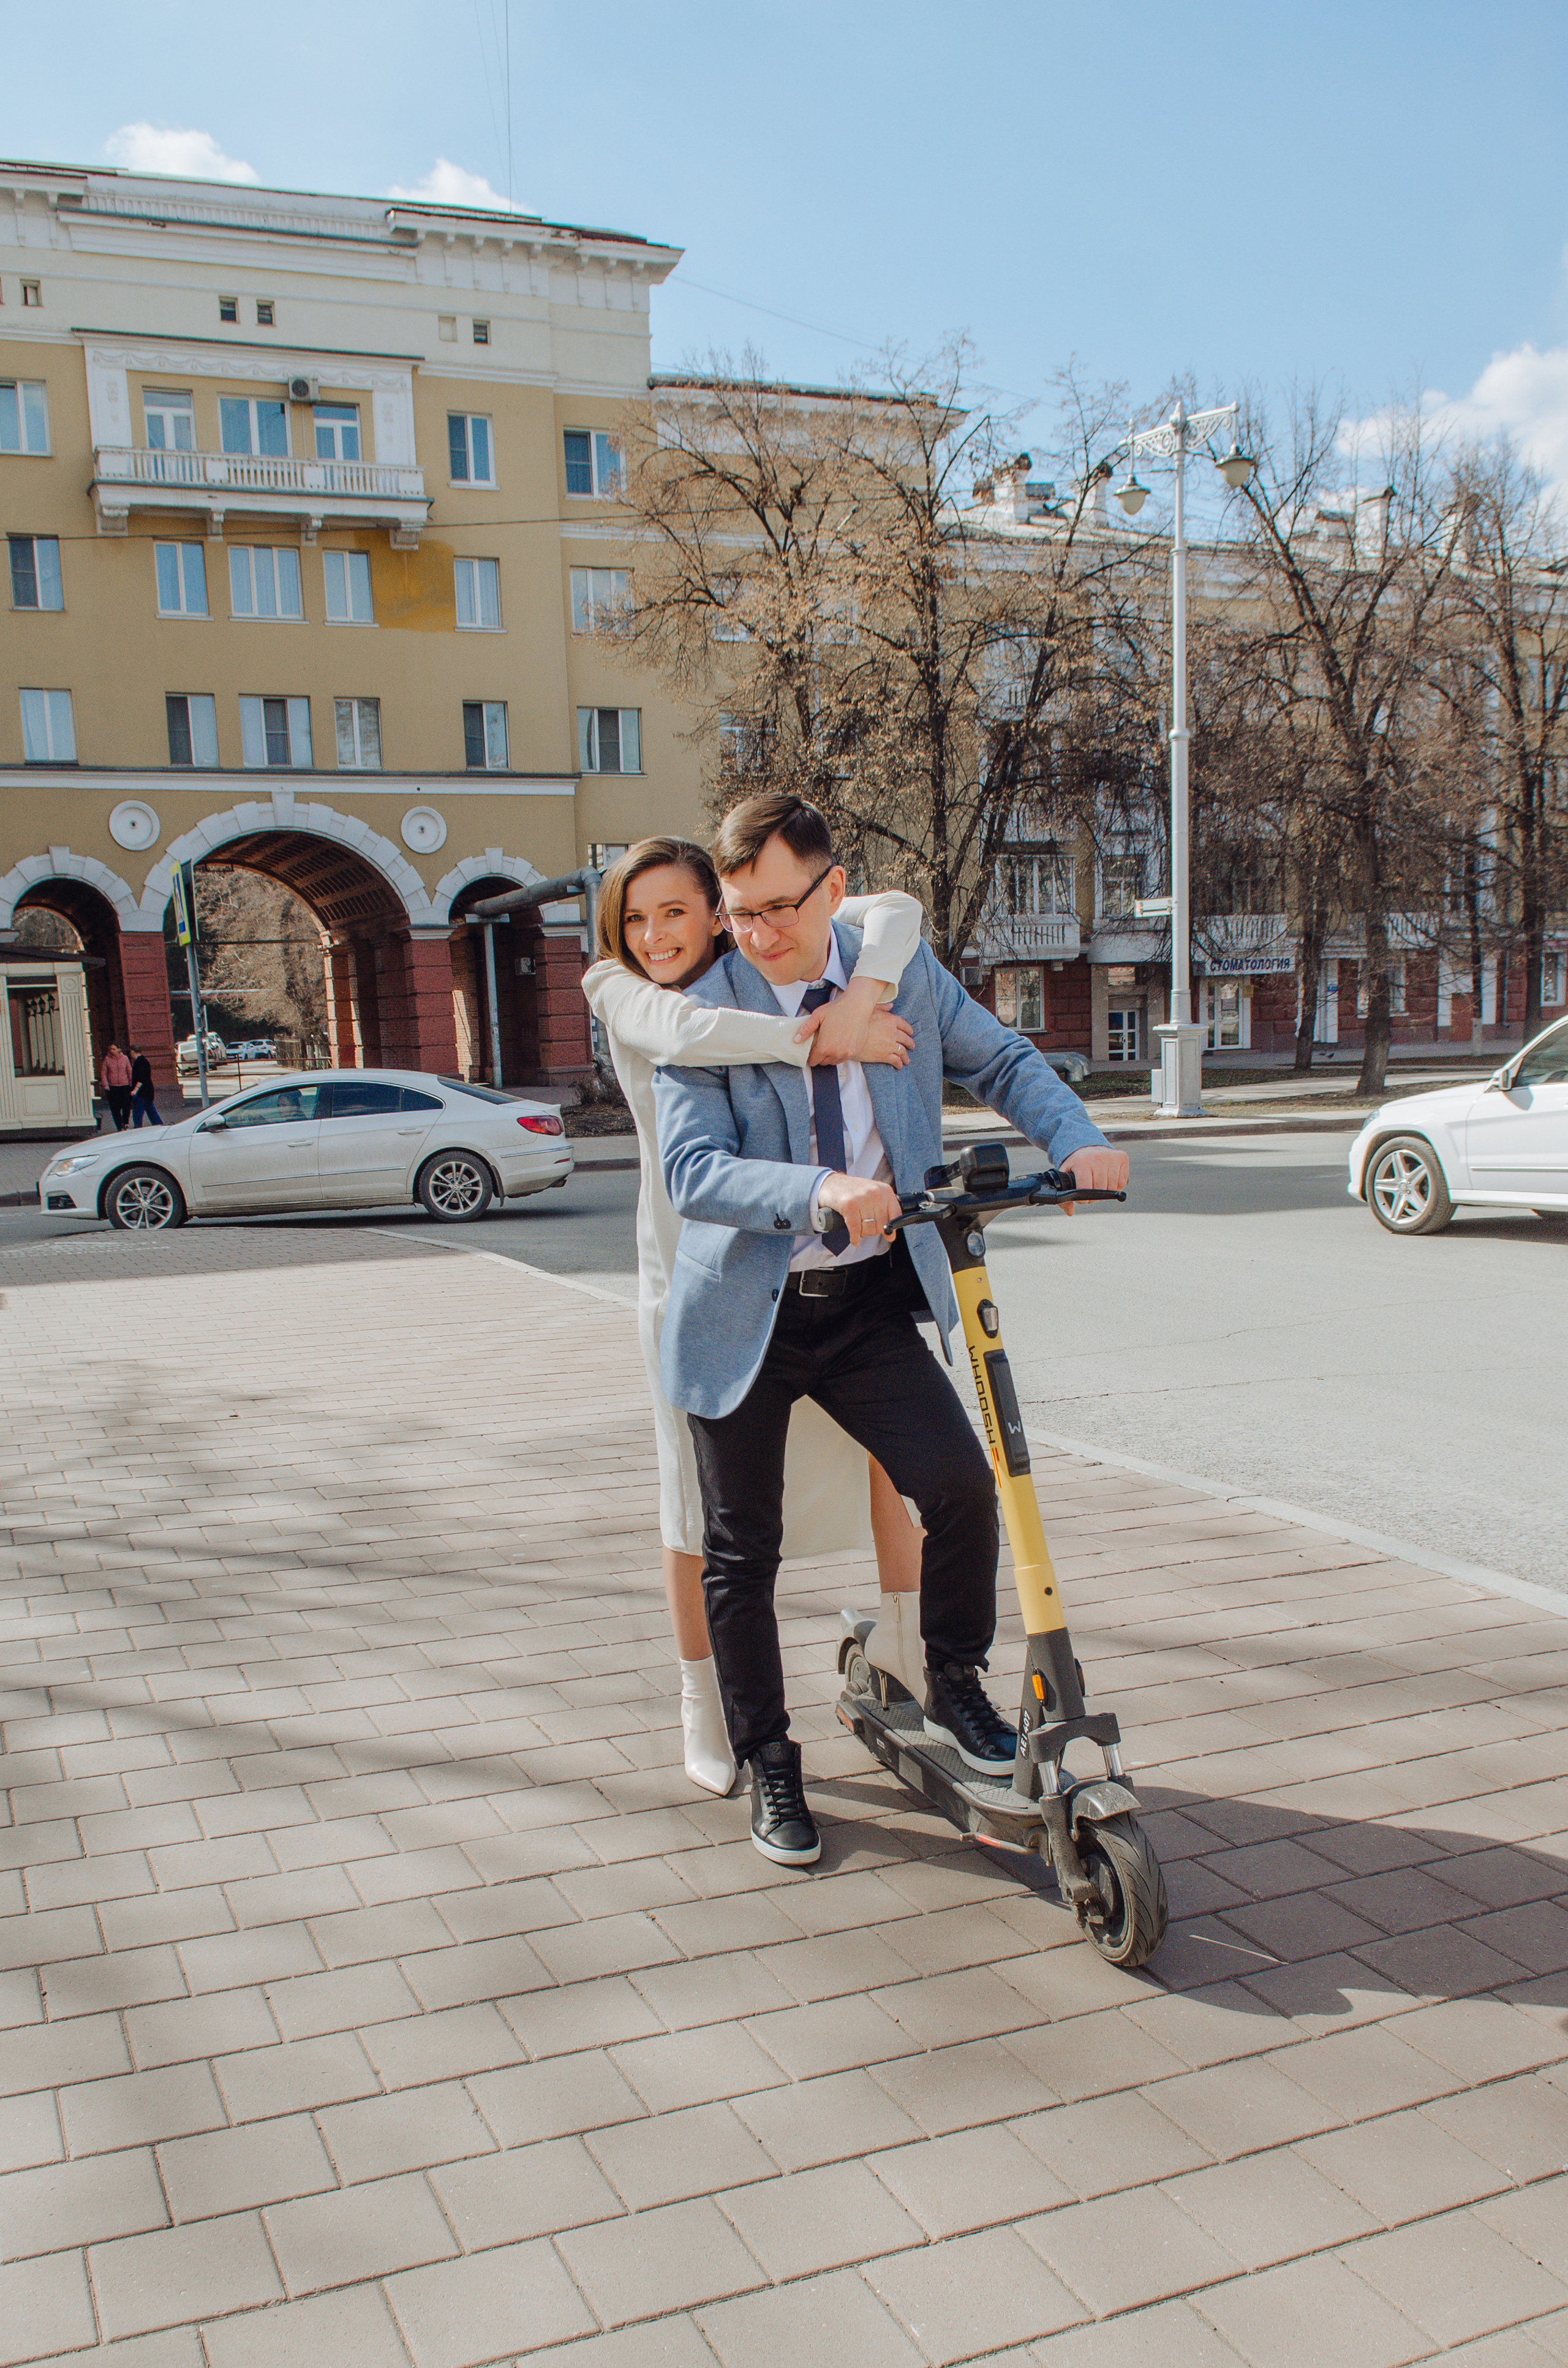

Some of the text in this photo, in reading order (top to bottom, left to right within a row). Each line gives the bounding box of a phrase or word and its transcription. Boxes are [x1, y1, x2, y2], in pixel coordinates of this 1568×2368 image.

[1210, 958, 1290, 972] СТОМАТОЛОГИЯ
[968, 1345, 996, 1444] WHOOSH
[1008, 1420, 1022, 1434] W
